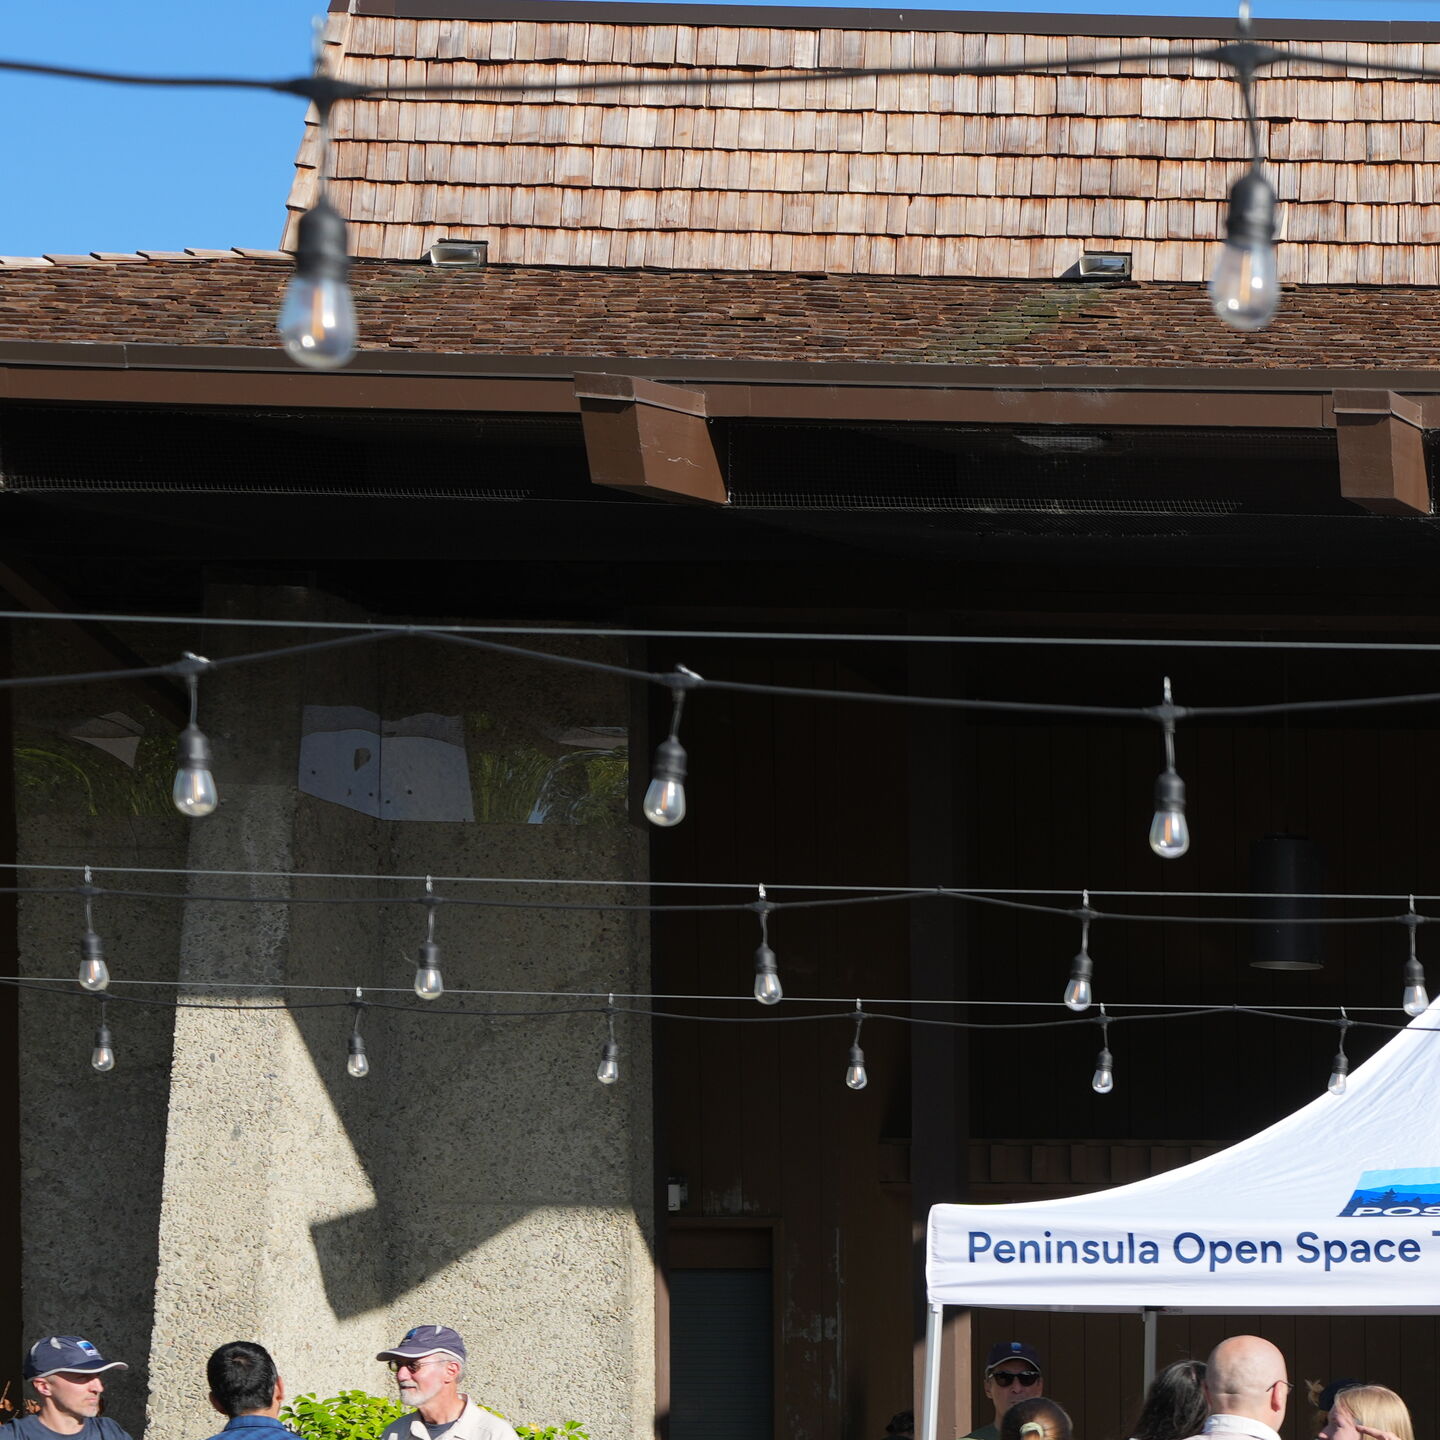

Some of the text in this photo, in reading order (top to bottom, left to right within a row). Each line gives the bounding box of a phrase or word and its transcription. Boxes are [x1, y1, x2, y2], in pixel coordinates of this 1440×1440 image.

[968, 1230, 1160, 1264] Peninsula
[1173, 1231, 1282, 1273] Open
[1296, 1231, 1421, 1272] Space
